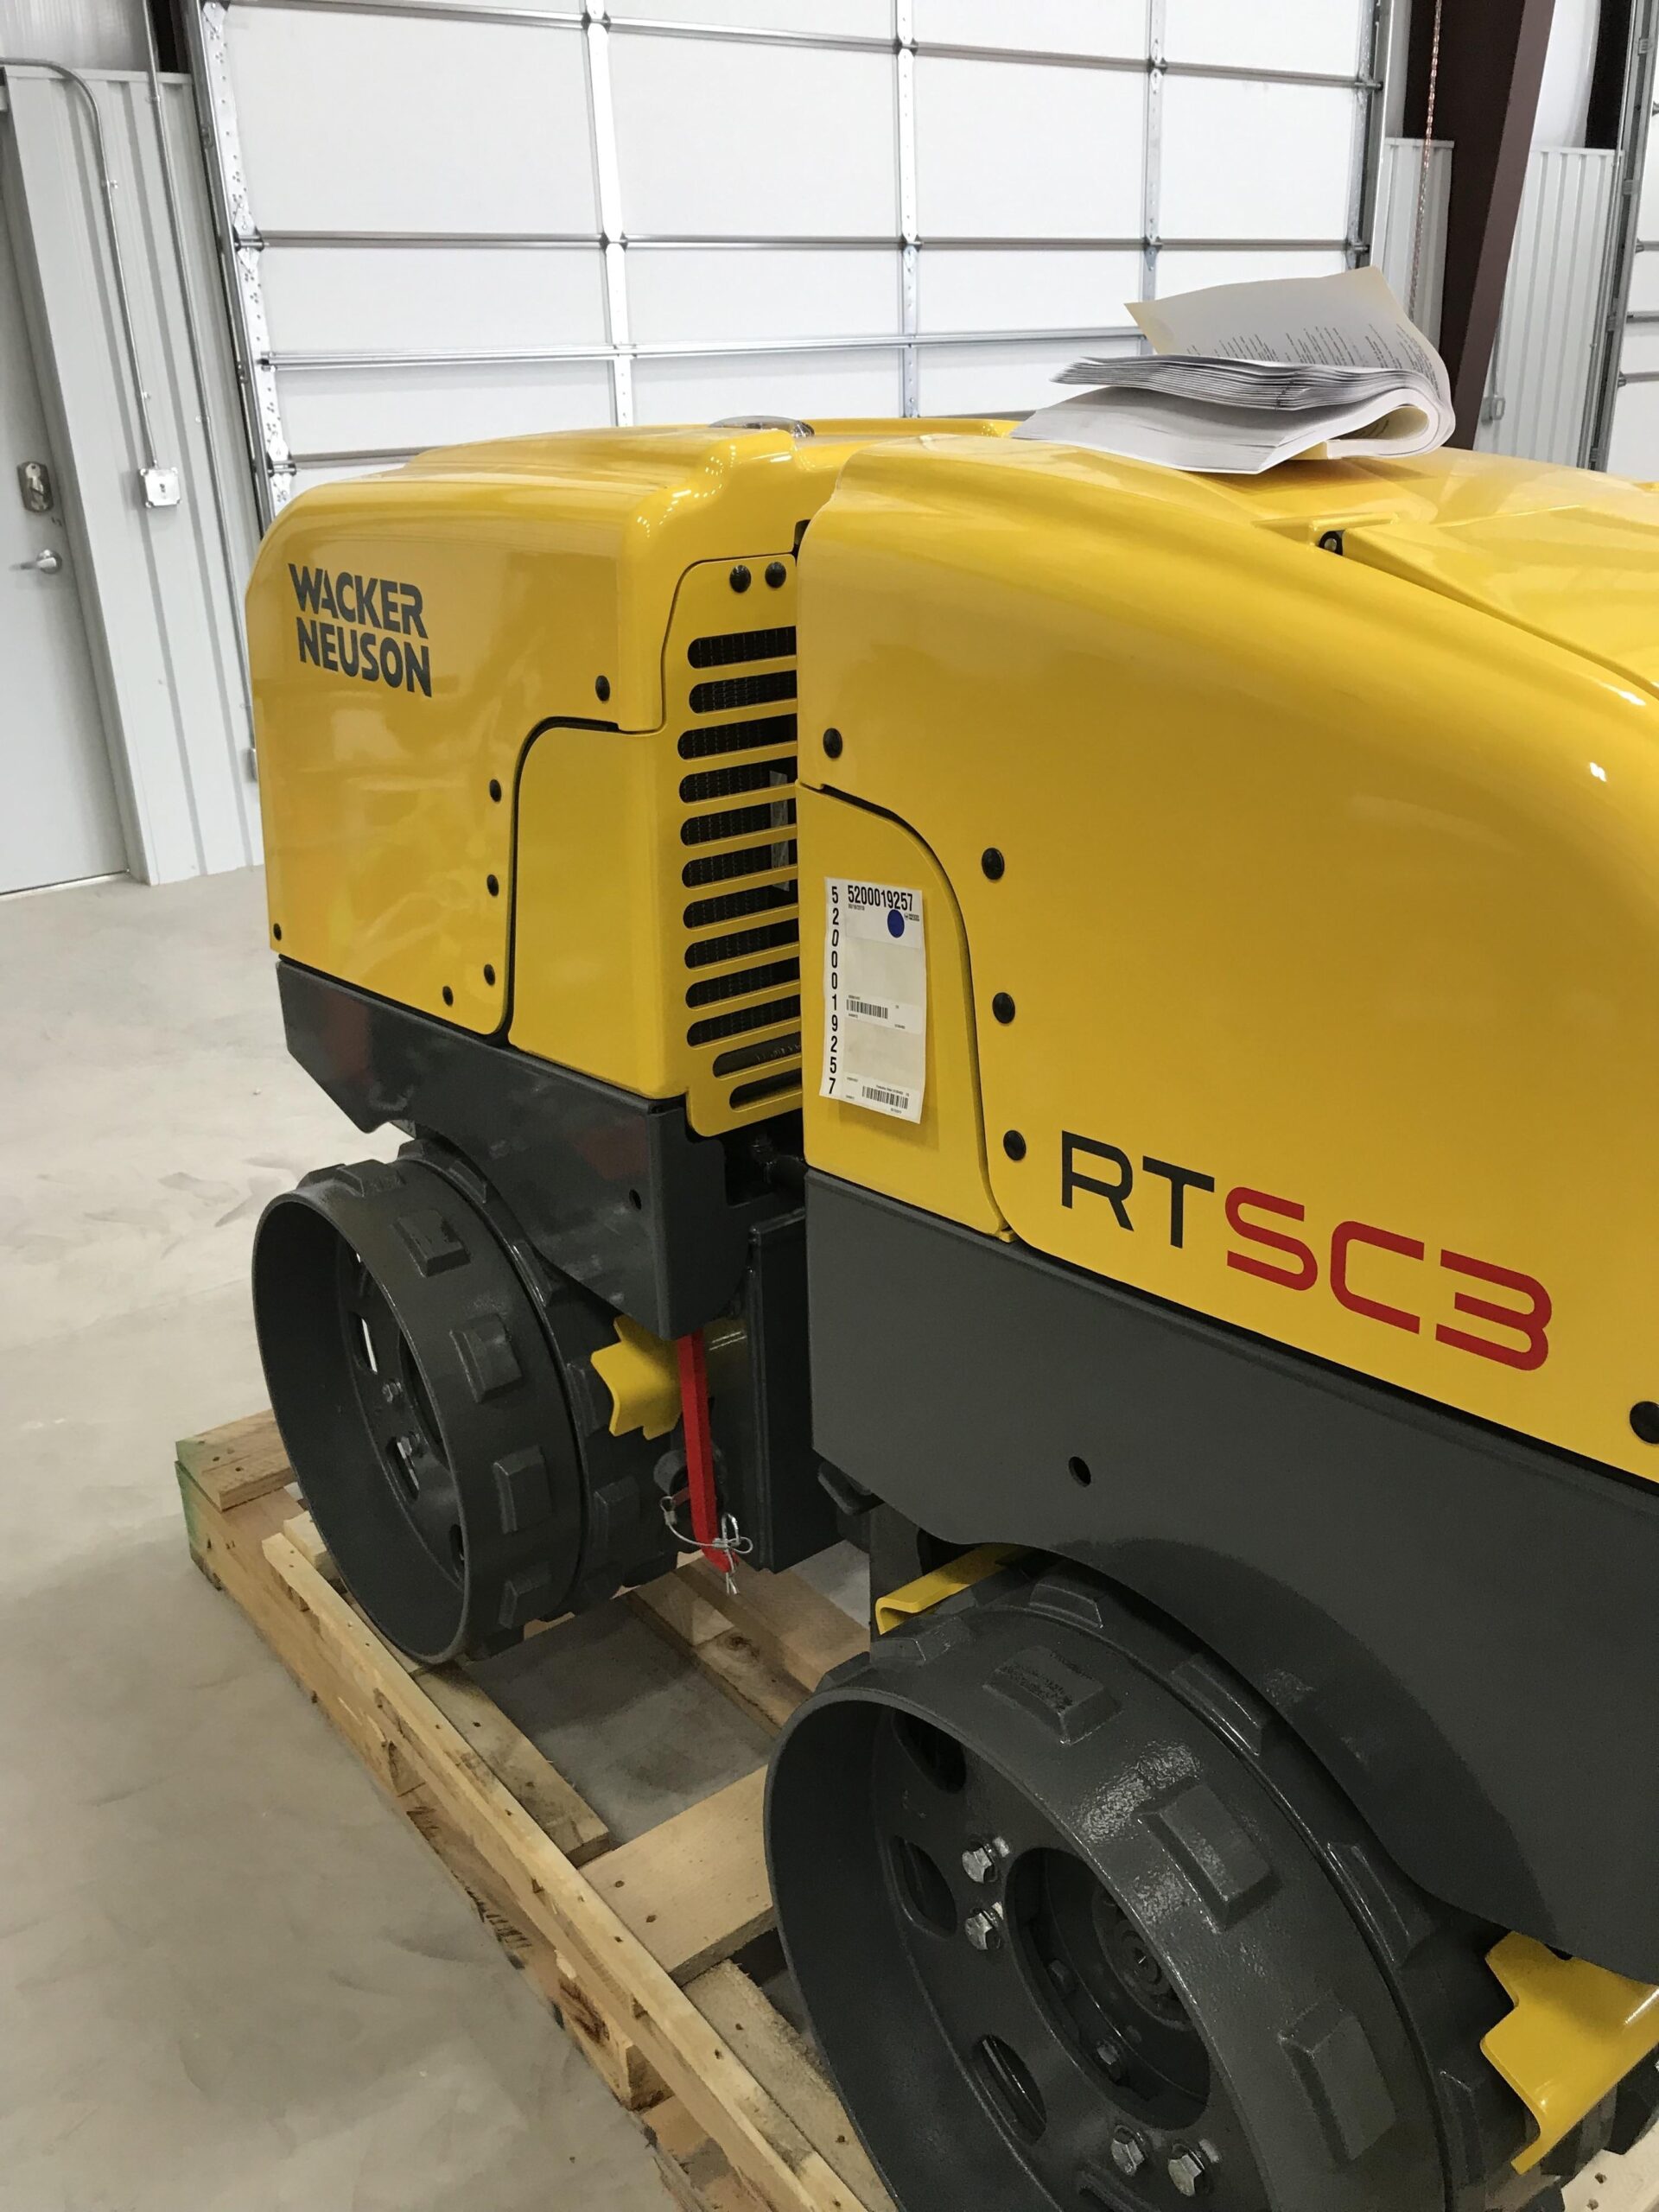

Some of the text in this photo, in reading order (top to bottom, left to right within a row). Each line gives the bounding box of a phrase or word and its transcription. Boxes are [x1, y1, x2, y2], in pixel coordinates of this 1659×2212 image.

[288, 563, 429, 639] WACKER
[296, 616, 433, 698] NEUSON
[848, 884, 913, 912] 5200019257
[1061, 1129, 1553, 1371] RTSC3
